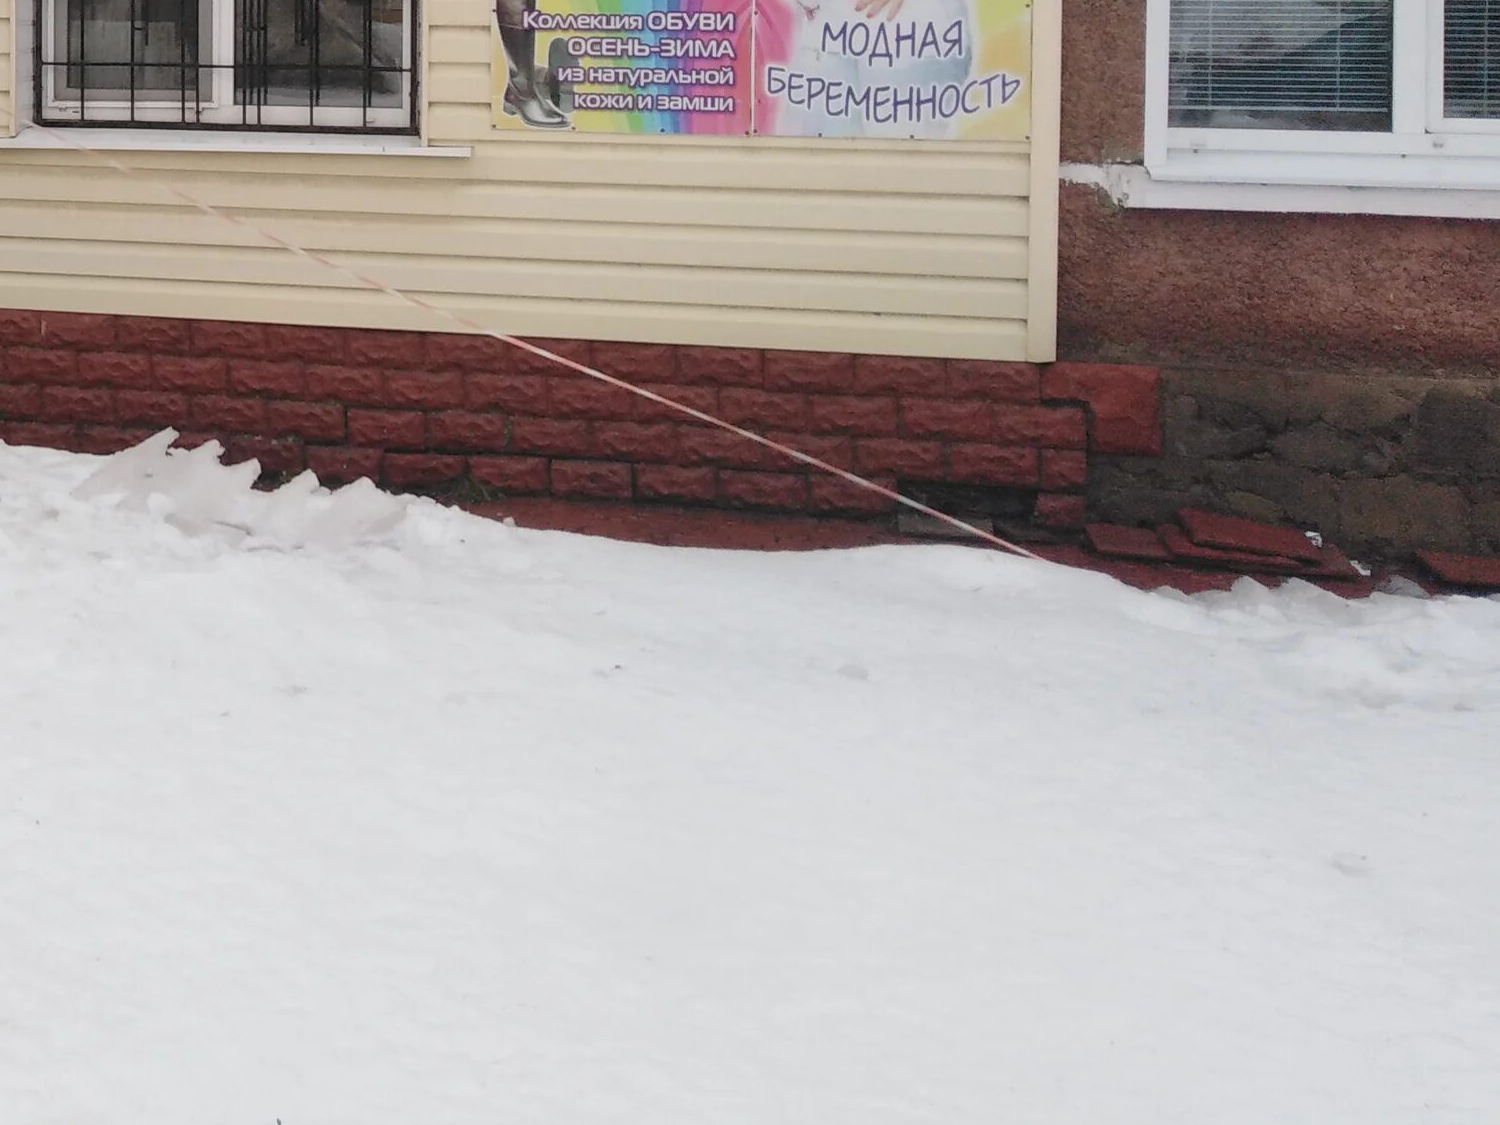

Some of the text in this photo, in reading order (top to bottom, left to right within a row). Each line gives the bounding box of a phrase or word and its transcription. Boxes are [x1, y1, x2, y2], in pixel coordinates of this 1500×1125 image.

[648, 12, 734, 31] ОБУВИ
[568, 38, 734, 57] ОСЕНЬ-ЗИМА
[822, 21, 963, 66] МОДНАЯ
[558, 66, 733, 85] из натуральной
[575, 94, 733, 111] кожи и замши
[768, 67, 1022, 121] БЕРЕМЕННОСТЬ
